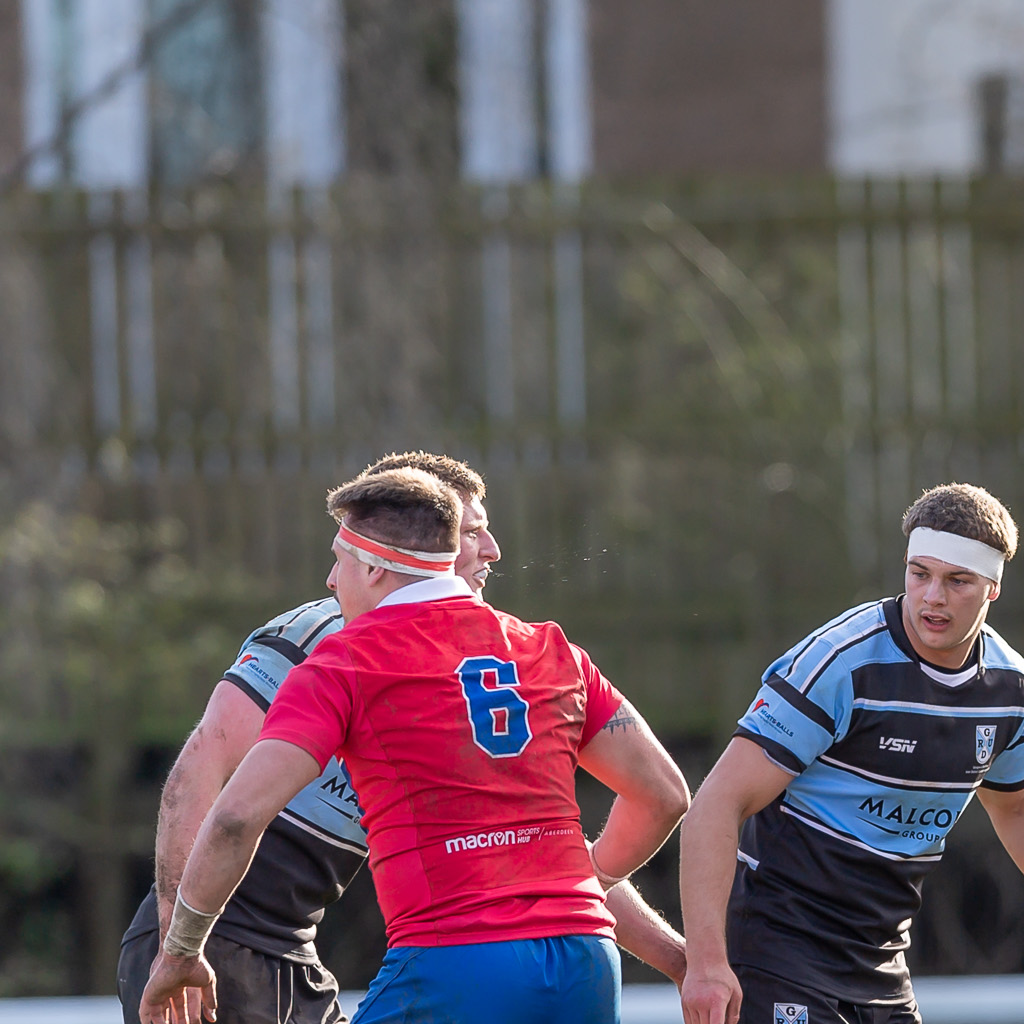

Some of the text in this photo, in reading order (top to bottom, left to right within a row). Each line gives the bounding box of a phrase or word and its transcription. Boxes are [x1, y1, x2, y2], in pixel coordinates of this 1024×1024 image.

[454, 655, 533, 758] 6
[879, 736, 917, 753] VSN
[858, 797, 961, 828] MALCO
[517, 827, 540, 837] SPORTS
[517, 835, 531, 843] HUB
[901, 830, 940, 843] GROUP
[445, 830, 516, 854] macron
